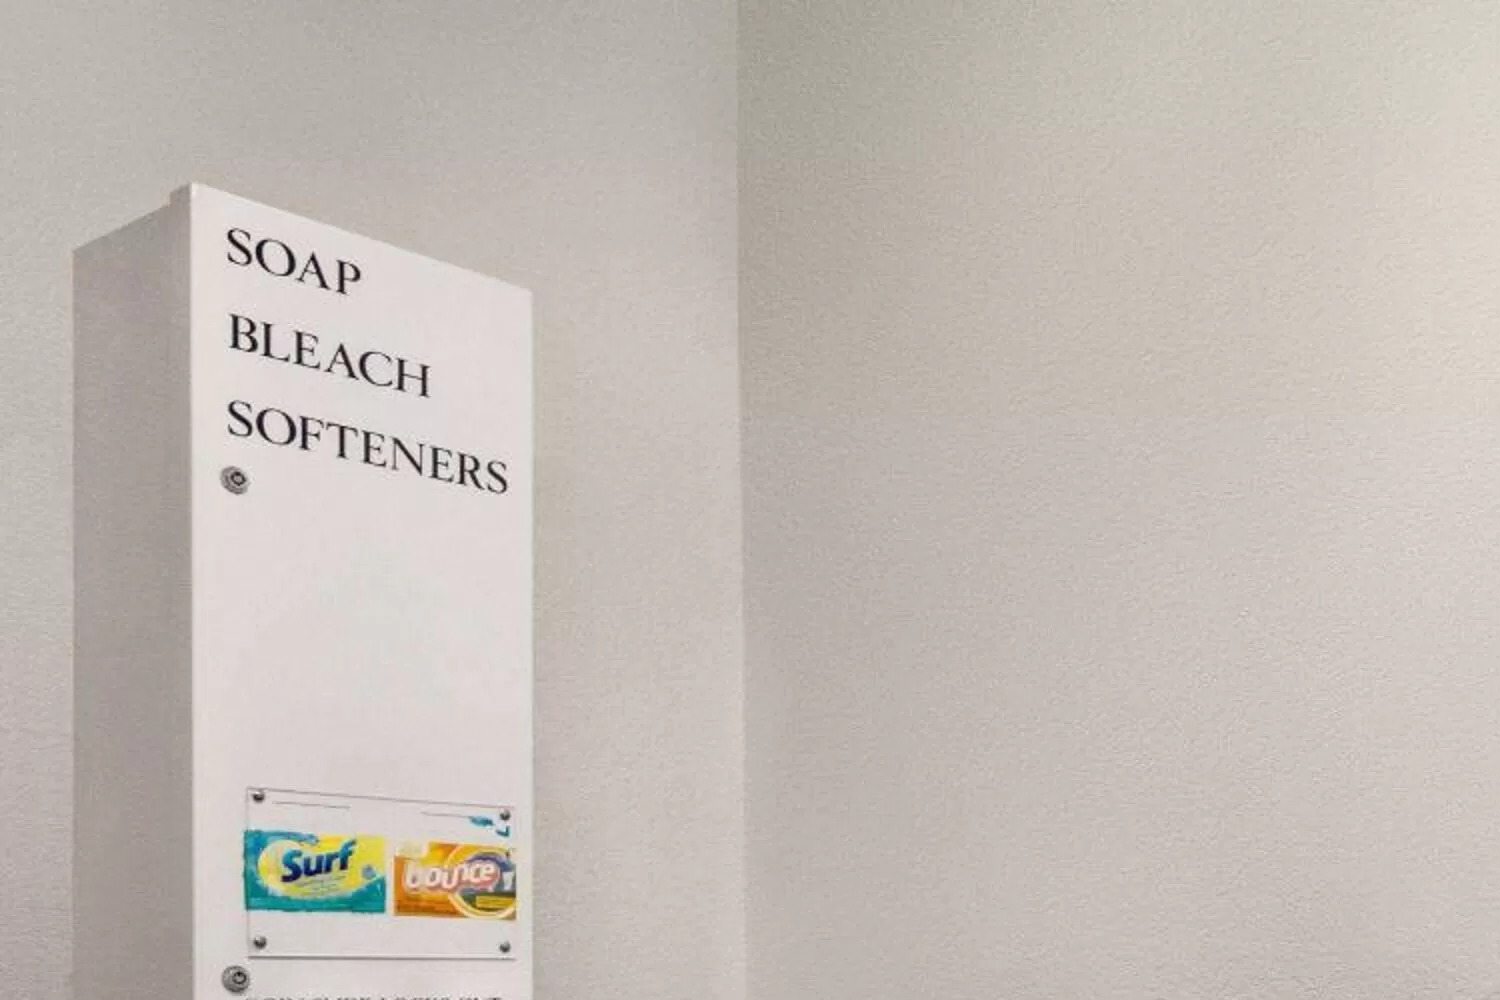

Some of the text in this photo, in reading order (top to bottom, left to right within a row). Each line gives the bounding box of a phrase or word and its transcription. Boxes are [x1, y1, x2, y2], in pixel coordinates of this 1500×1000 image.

[227, 228, 361, 296] SOAP
[228, 313, 431, 398] BLEACH
[227, 400, 509, 494] SOFTENERS
[281, 838, 357, 883] Surf
[404, 860, 497, 891] bounce
